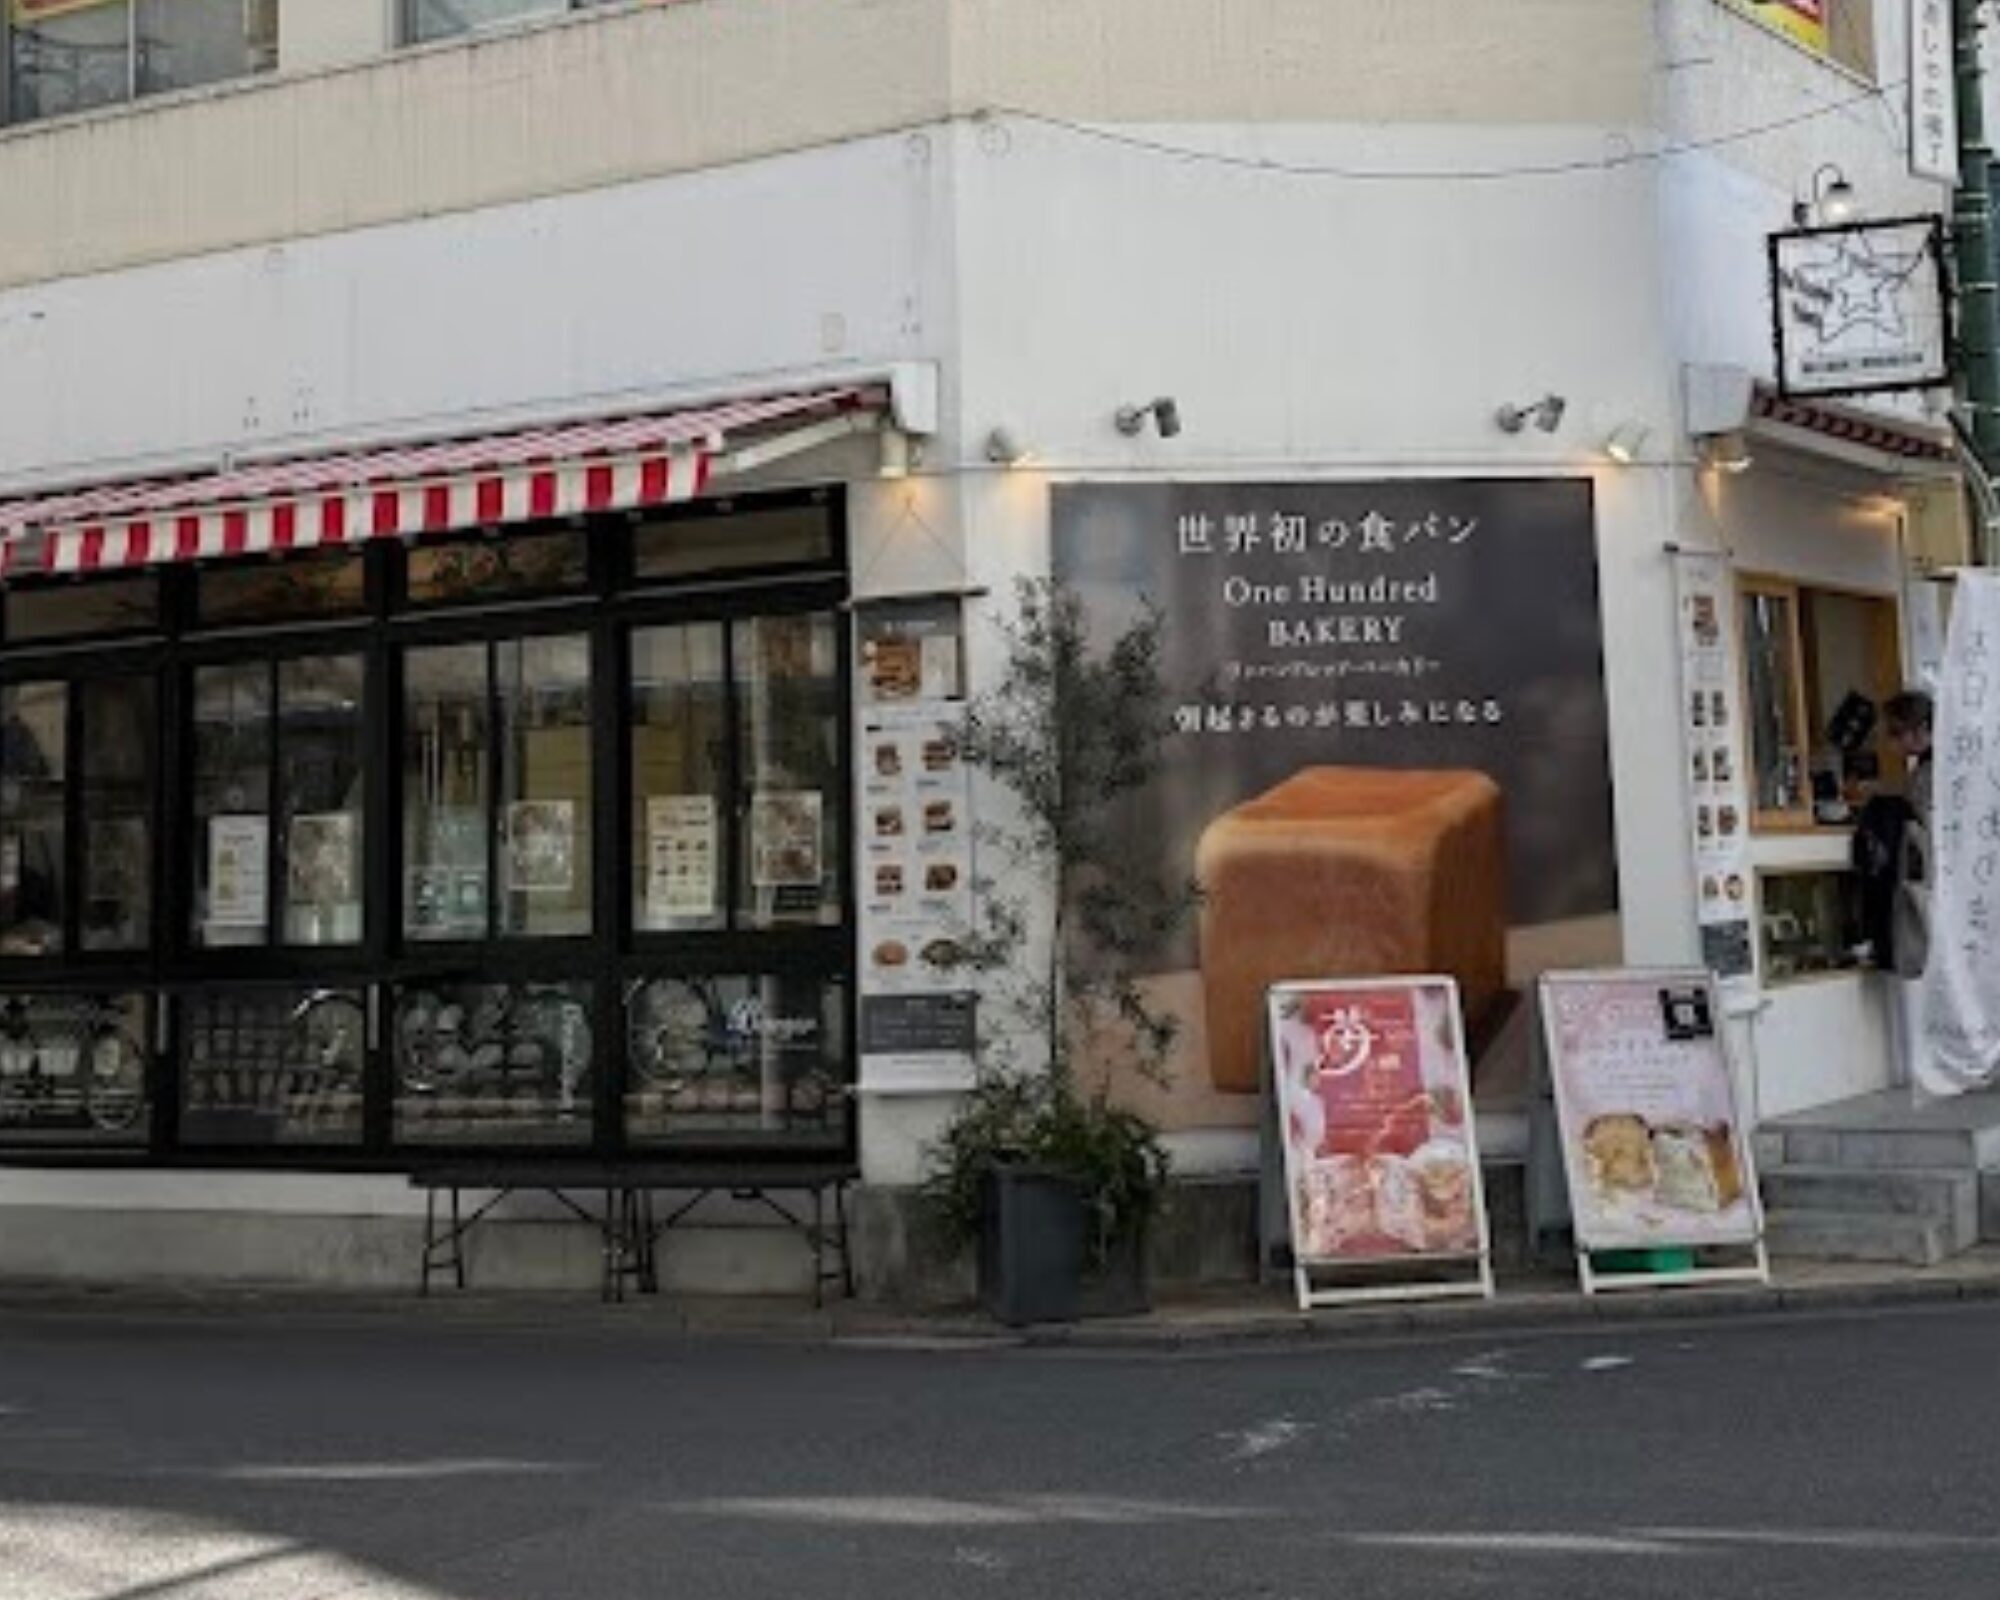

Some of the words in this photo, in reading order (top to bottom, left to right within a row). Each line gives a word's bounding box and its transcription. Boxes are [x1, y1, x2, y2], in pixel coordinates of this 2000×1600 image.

[1178, 510, 1478, 554] 世界初の食パン
[1224, 576, 1289, 606] One
[1301, 573, 1436, 602] Hundred
[1269, 616, 1404, 647] BAKERY
